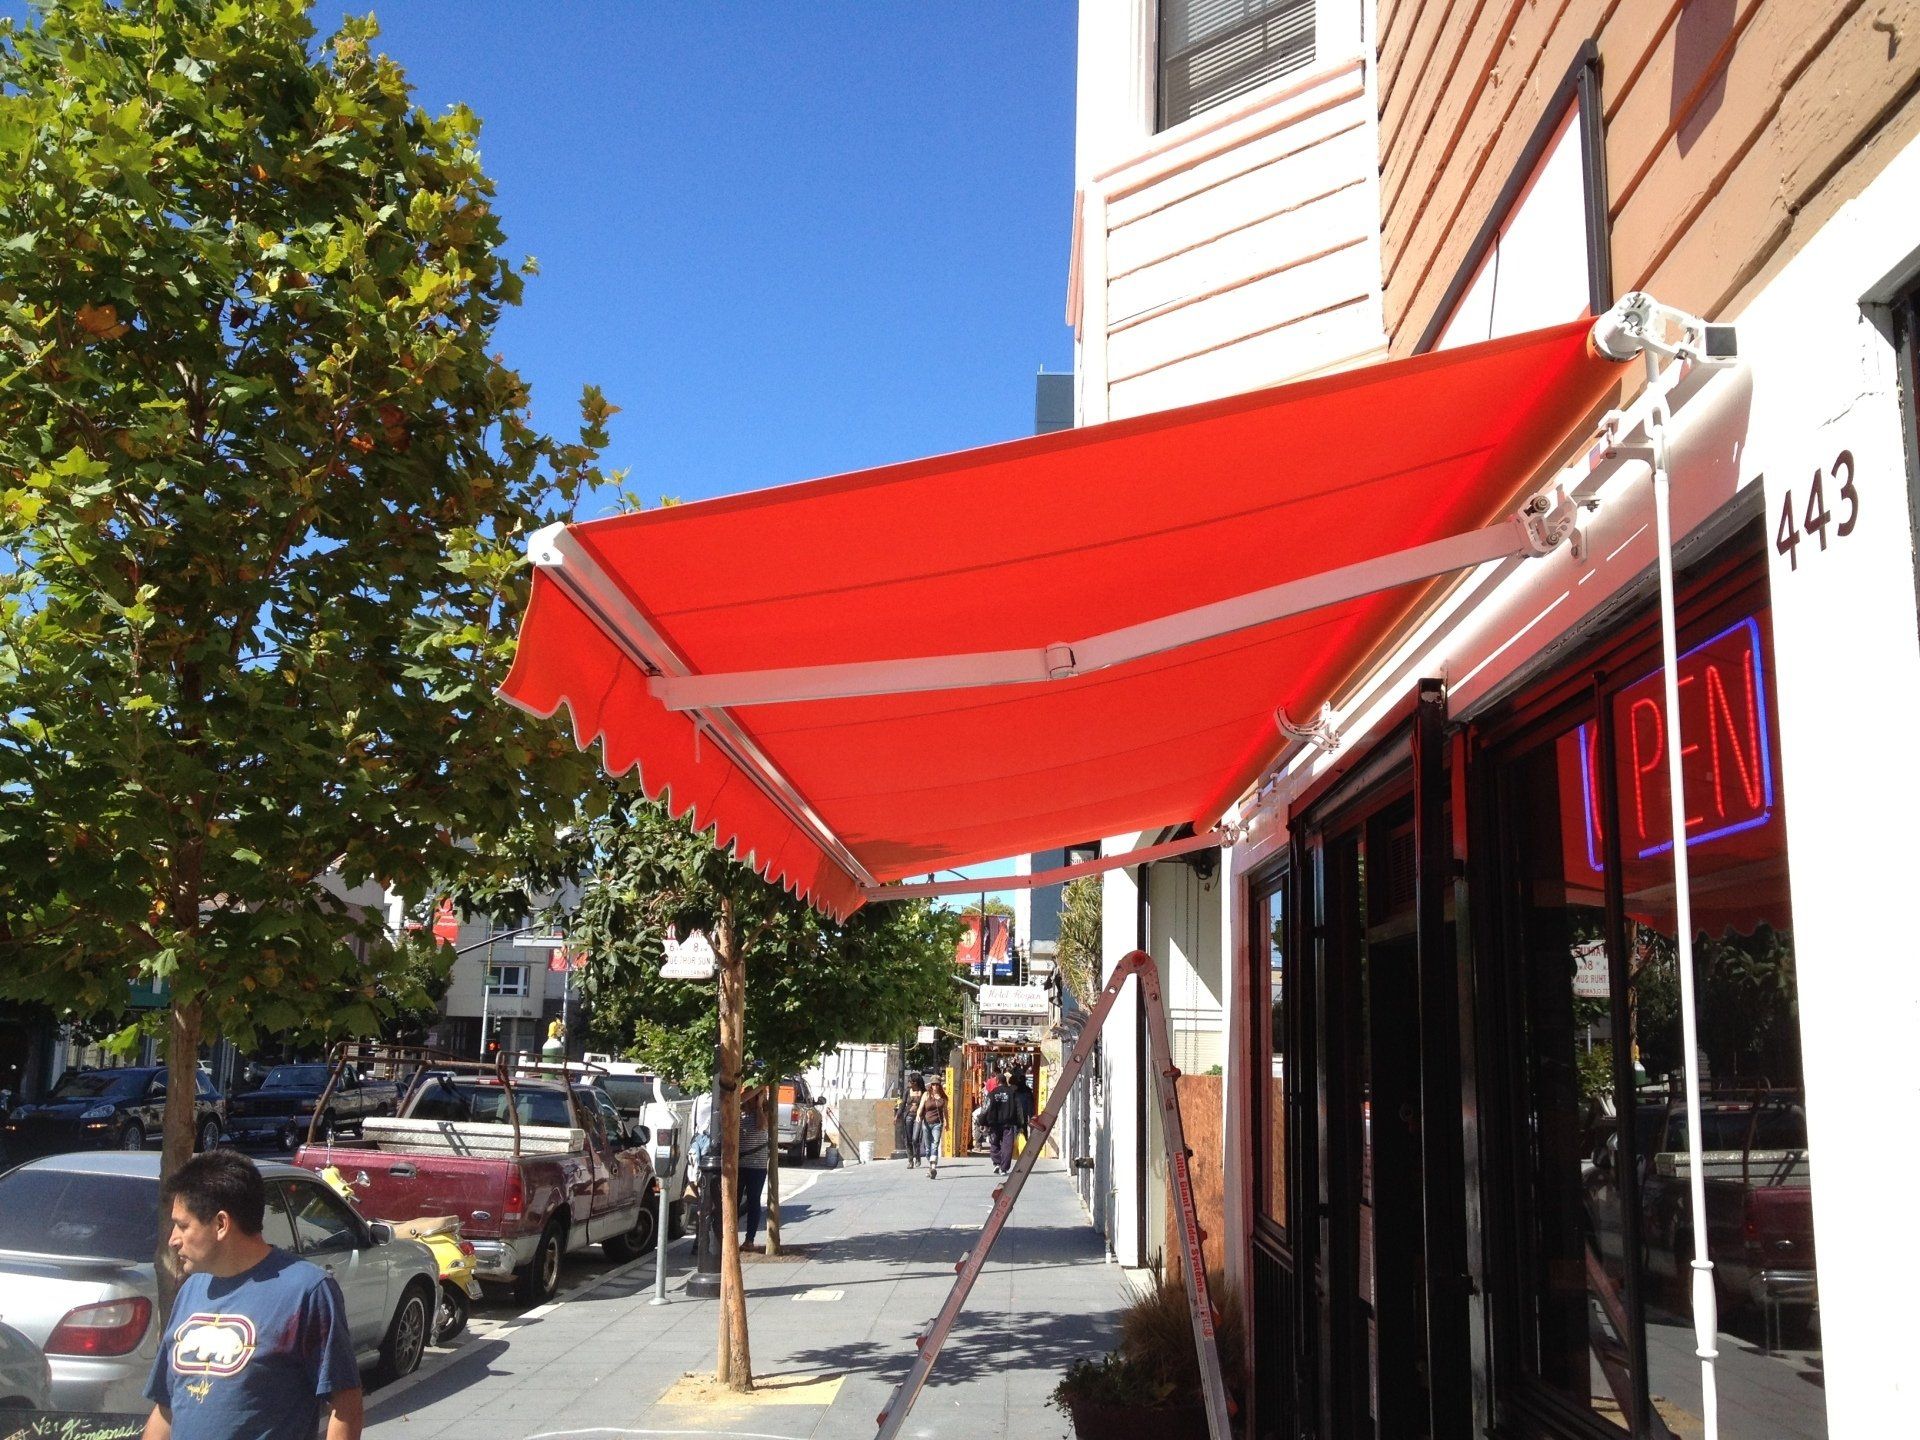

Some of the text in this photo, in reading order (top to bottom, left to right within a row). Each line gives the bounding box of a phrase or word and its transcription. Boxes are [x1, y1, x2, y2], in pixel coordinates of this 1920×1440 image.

[1776, 449, 1859, 572] 443
[990, 1015, 1040, 1026] HOTEL
[1175, 1152, 1204, 1294] Little Giant Ladder Systems
